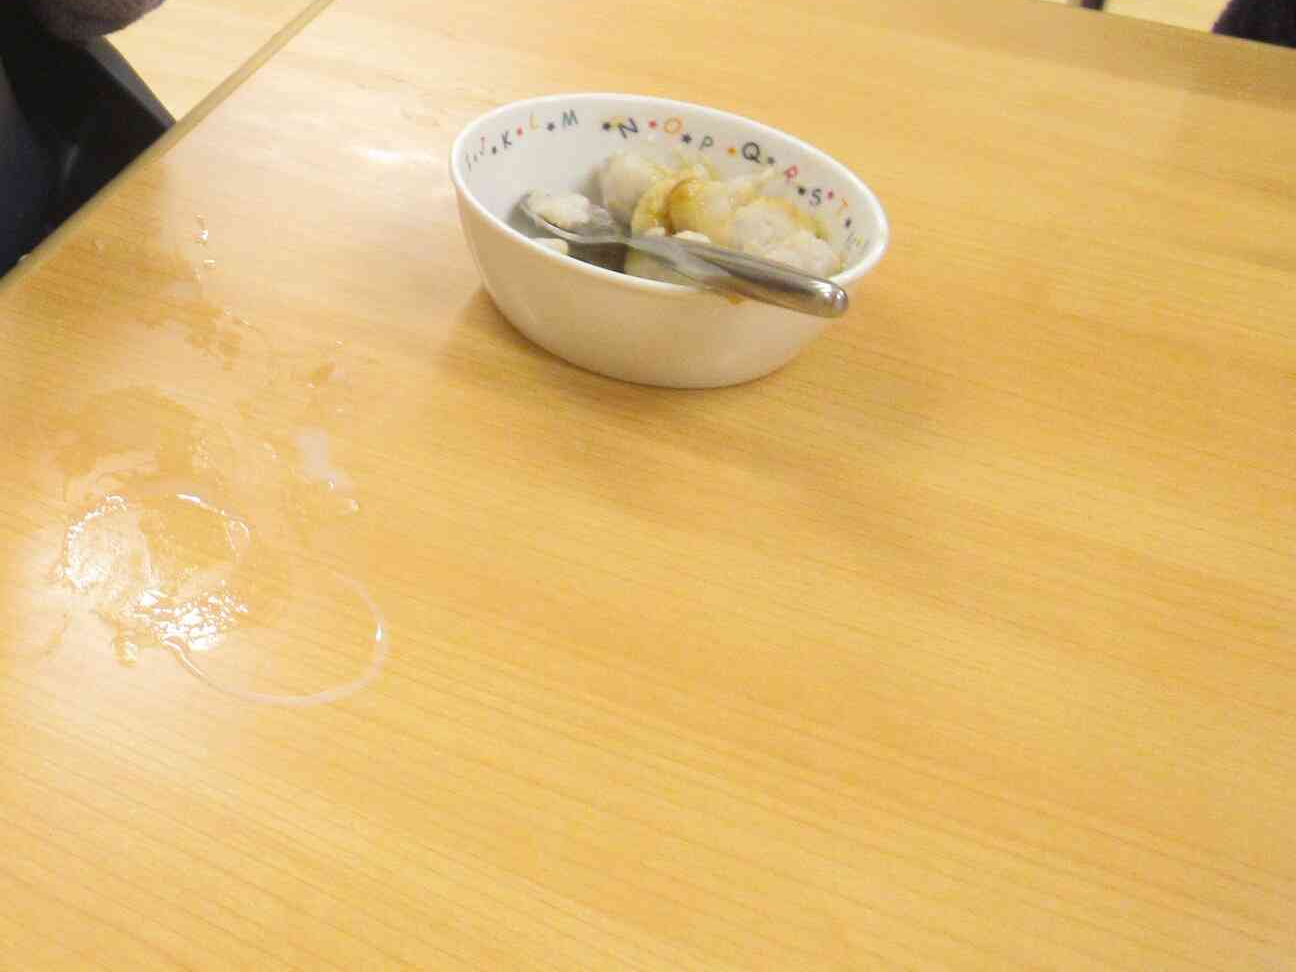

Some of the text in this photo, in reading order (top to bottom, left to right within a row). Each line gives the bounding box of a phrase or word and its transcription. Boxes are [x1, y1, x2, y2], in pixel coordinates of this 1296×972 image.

[502, 130, 512, 149] K
[561, 109, 579, 128] M
[617, 117, 639, 139] N
[663, 117, 683, 134] O
[697, 135, 713, 150] P
[742, 141, 761, 163] Q
[809, 188, 822, 206] S
